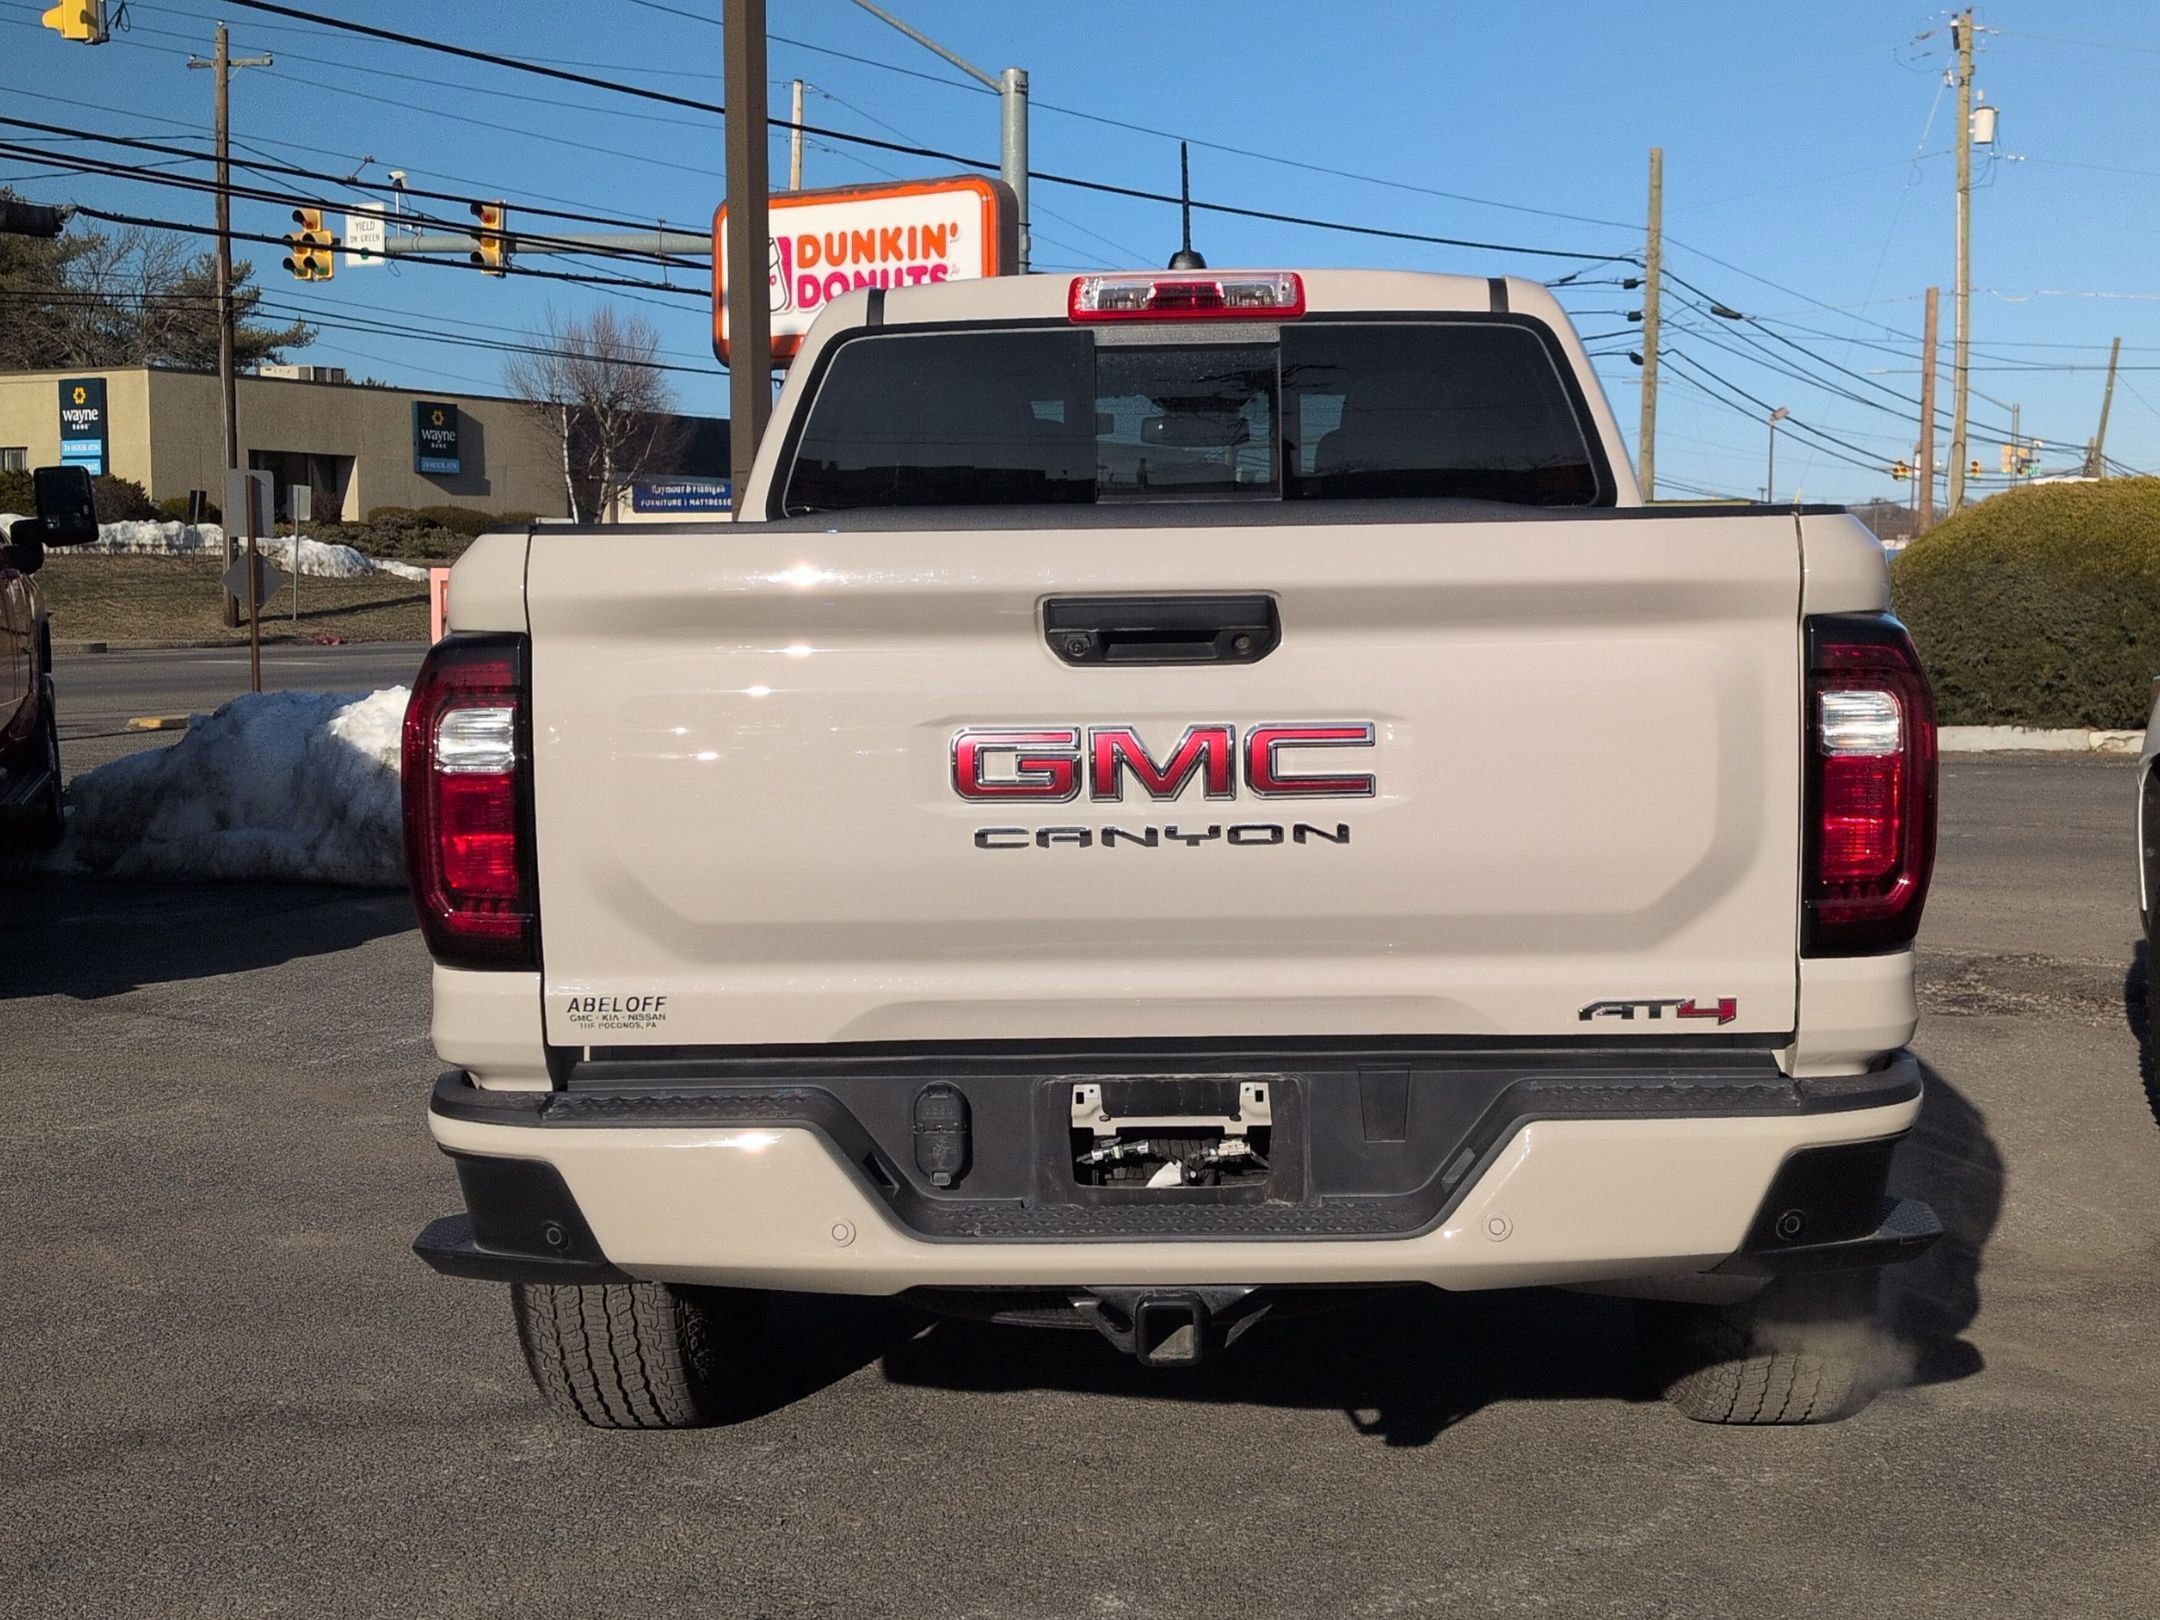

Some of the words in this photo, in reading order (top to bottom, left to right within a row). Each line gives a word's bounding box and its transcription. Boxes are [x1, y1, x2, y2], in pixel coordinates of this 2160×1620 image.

[355, 221, 376, 232] YIELD
[797, 222, 959, 269] DUNKIN'
[62, 408, 99, 424] wayne
[421, 429, 456, 444] wayne
[640, 499, 682, 507] FURNITURE
[689, 498, 732, 506] MATTRESSE
[950, 723, 1377, 803] GMC
[974, 823, 1350, 849] CANYON
[567, 996, 668, 1013] ABELOFF
[1578, 997, 1737, 1026] AT4
[569, 1014, 593, 1022] GMC
[628, 1013, 666, 1021] NISSAN
